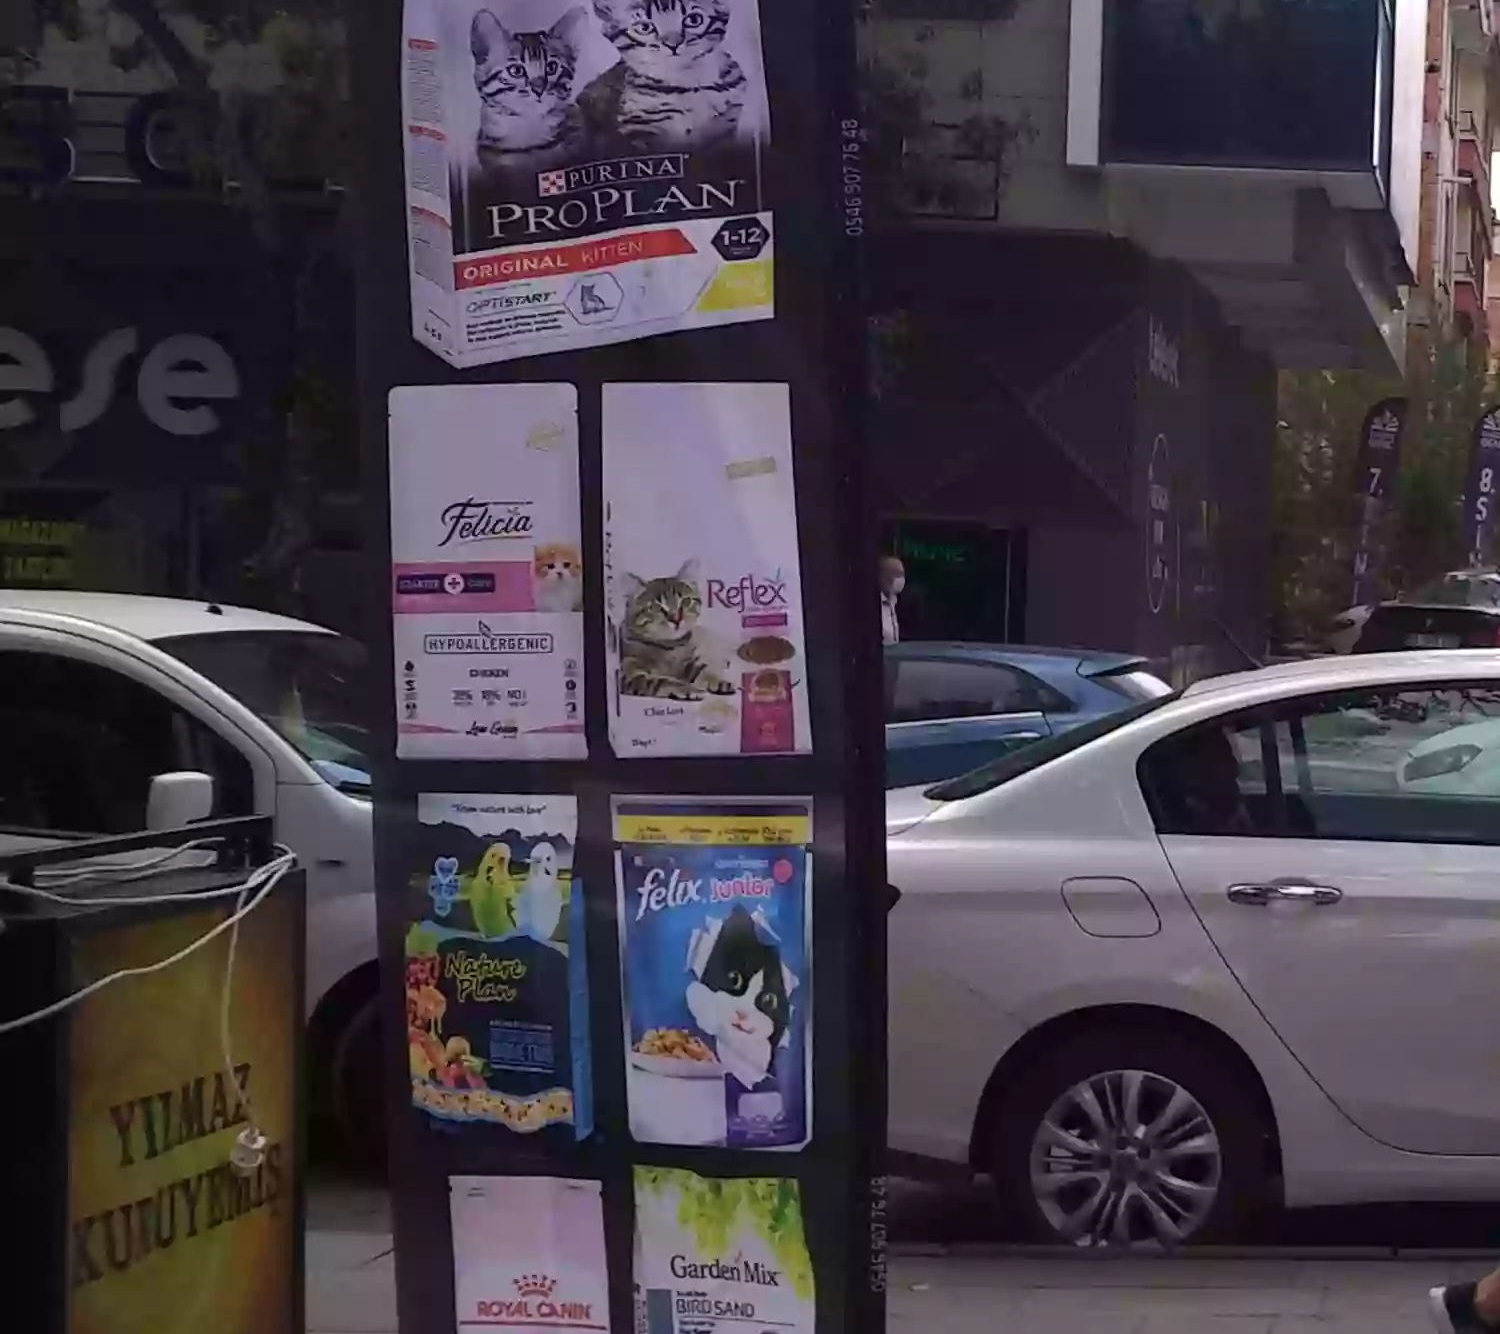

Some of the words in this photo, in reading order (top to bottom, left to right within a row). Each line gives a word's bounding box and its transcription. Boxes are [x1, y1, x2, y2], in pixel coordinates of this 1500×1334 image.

[569, 158, 677, 189] PURINA
[720, 227, 761, 246] 1-12
[581, 238, 643, 265] KITTEN
[463, 254, 569, 280] ORIGINAL
[438, 496, 534, 547] Felicia
[706, 574, 788, 614] Reflex
[428, 637, 549, 652] HYPOALLERGENIC
[444, 951, 527, 979] Nature
[457, 974, 517, 1003] Plan
[110, 1063, 251, 1167] YILMAZ
[670, 1255, 741, 1282] Garden
[743, 1260, 782, 1287] Mix
[477, 1300, 532, 1318] ROYAL
[536, 1301, 592, 1319] CANIN
[676, 1298, 711, 1315] BIRD
[714, 1300, 755, 1318] SAND
